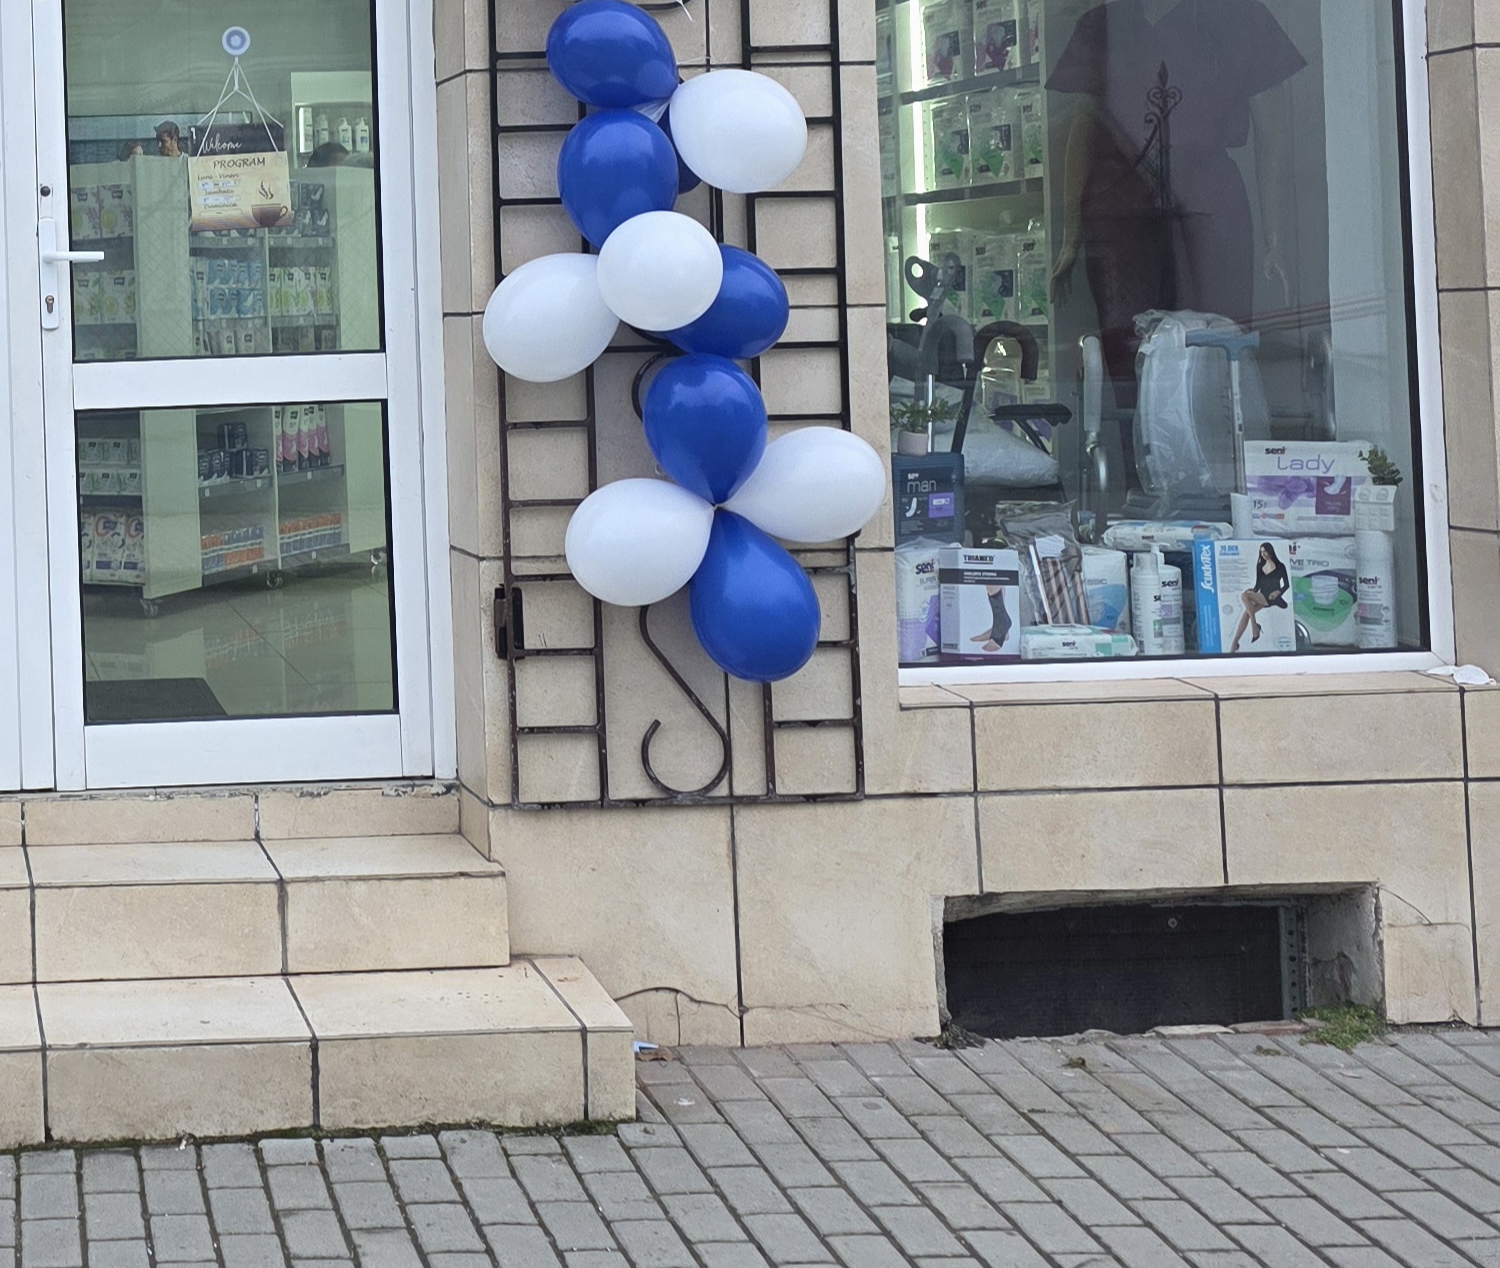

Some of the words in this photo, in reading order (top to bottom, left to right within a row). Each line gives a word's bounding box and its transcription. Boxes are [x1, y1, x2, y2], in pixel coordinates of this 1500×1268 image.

[213, 157, 266, 169] PROGRAM
[1264, 446, 1285, 455] seni
[1277, 454, 1336, 474] Lady
[907, 480, 937, 493] man
